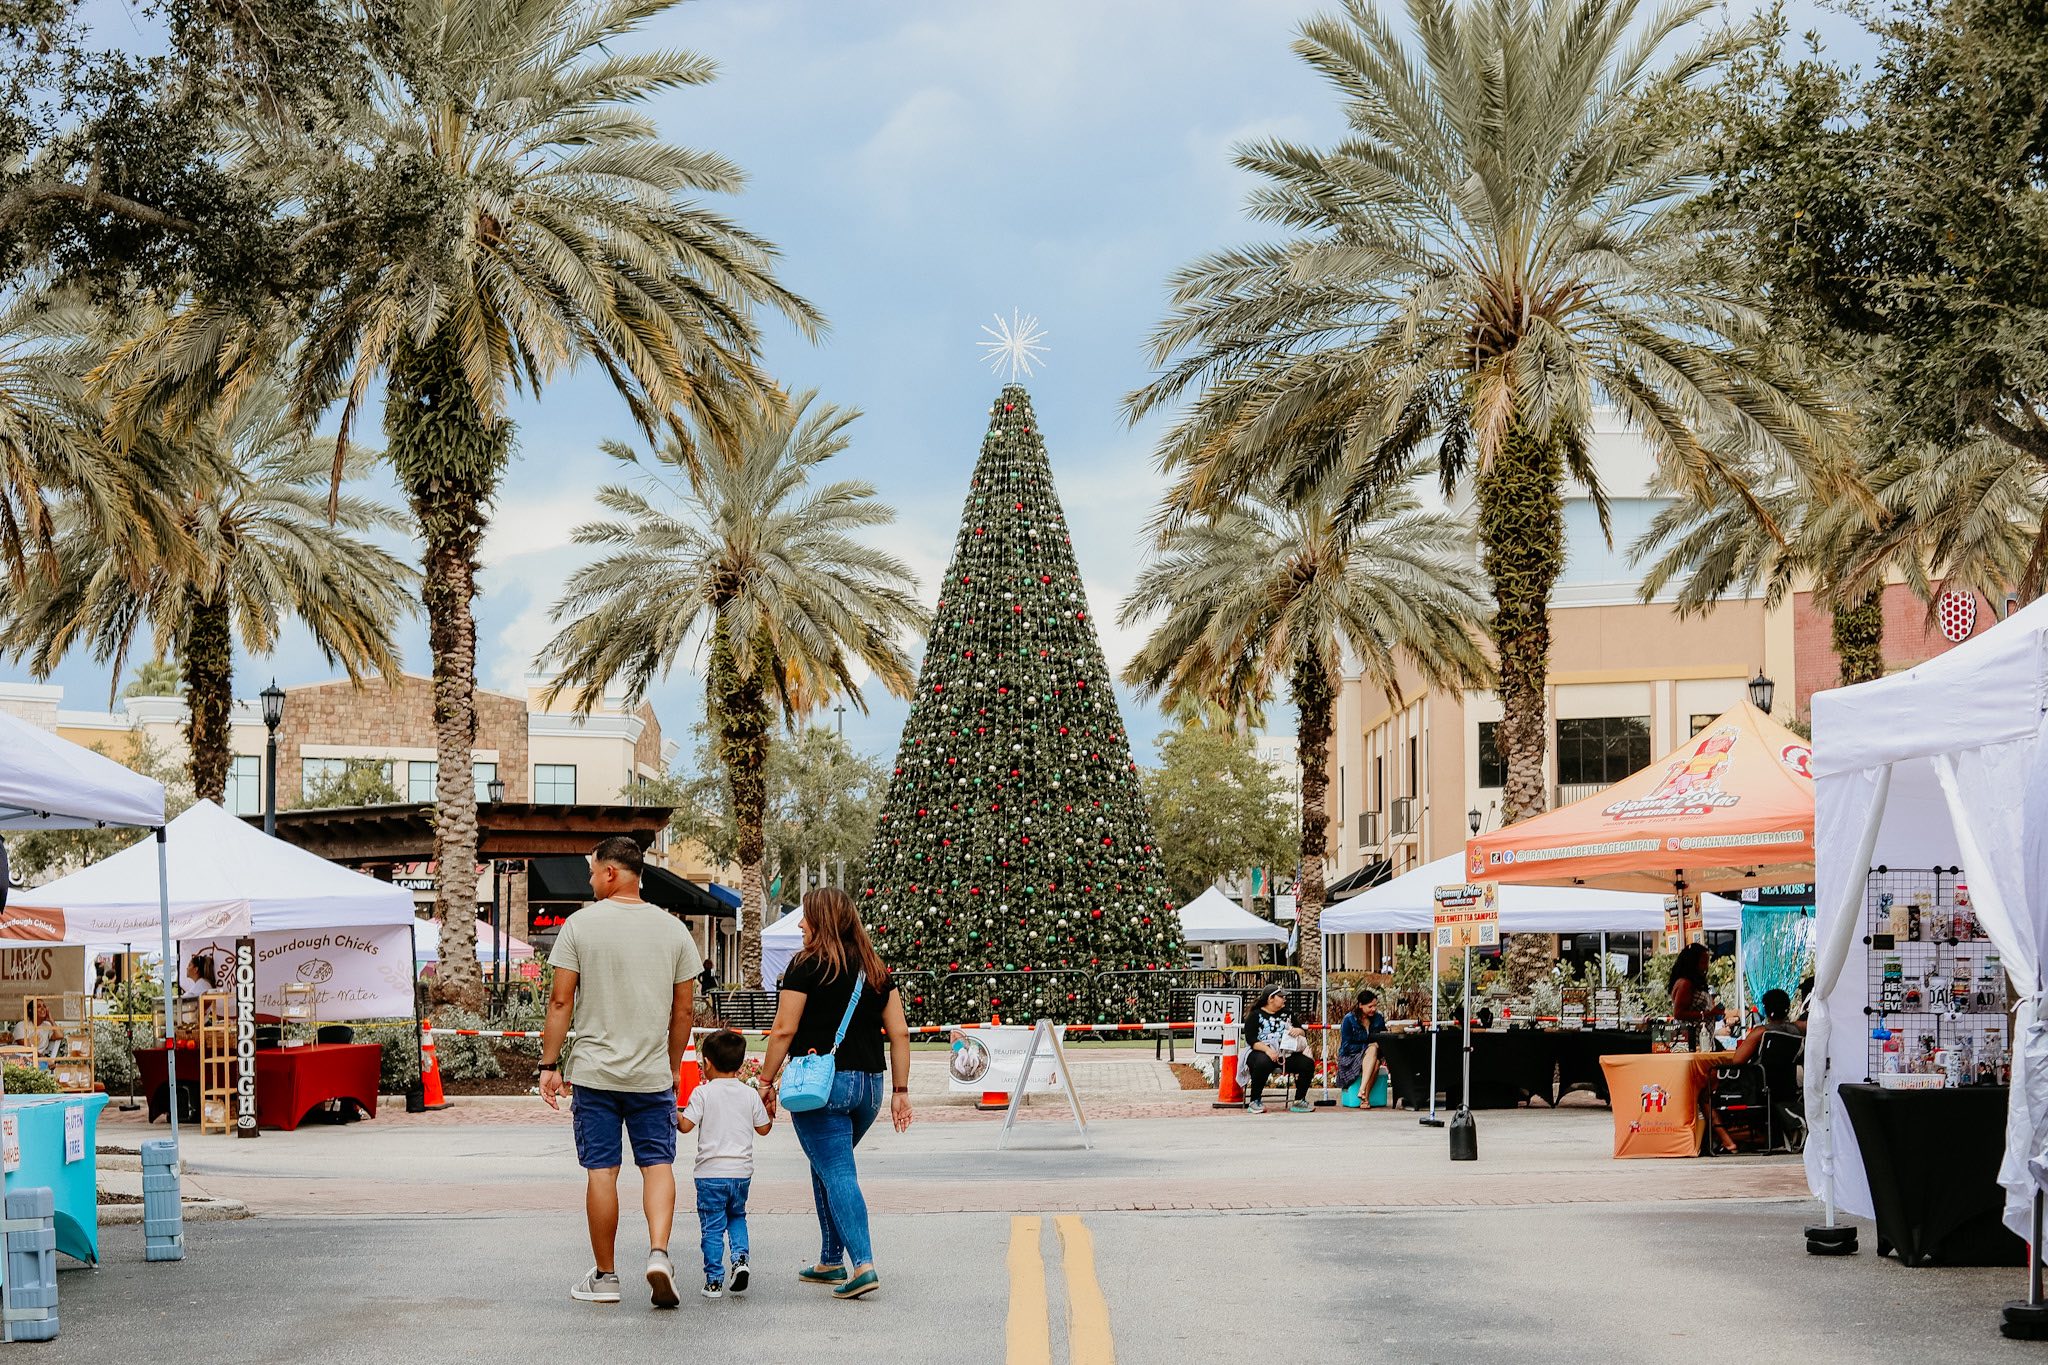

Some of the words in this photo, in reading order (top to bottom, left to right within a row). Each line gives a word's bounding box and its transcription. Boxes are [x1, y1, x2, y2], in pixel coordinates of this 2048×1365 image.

[1604, 797, 1683, 815] Granny
[1685, 792, 1740, 807] Mac
[1680, 830, 1804, 849] @GRANNYMACBEVERAGECO
[1516, 839, 1660, 862] @GRANNYMACBEVERAGECOMPANY
[401, 879, 433, 890] CANDY
[1462, 884, 1483, 898] Mac
[1761, 885, 1779, 895] SEA
[1780, 883, 1806, 895] MOSS
[1434, 915, 1446, 923] FREE
[1447, 914, 1462, 922] SWEET
[1464, 913, 1473, 921] TEA
[1474, 911, 1498, 920] SAMPLES
[33, 919, 57, 934] Chicks
[258, 934, 331, 962] Sourdough
[335, 934, 379, 956] Chicks
[337, 986, 379, 1002] Water
[1202, 1000, 1234, 1014] ONE
[237, 945, 256, 1116] SOURDOUGH
[3, 1120, 13, 1136] FREE
[65, 1113, 83, 1130] GLUTEN
[69, 1140, 80, 1156] FREE
